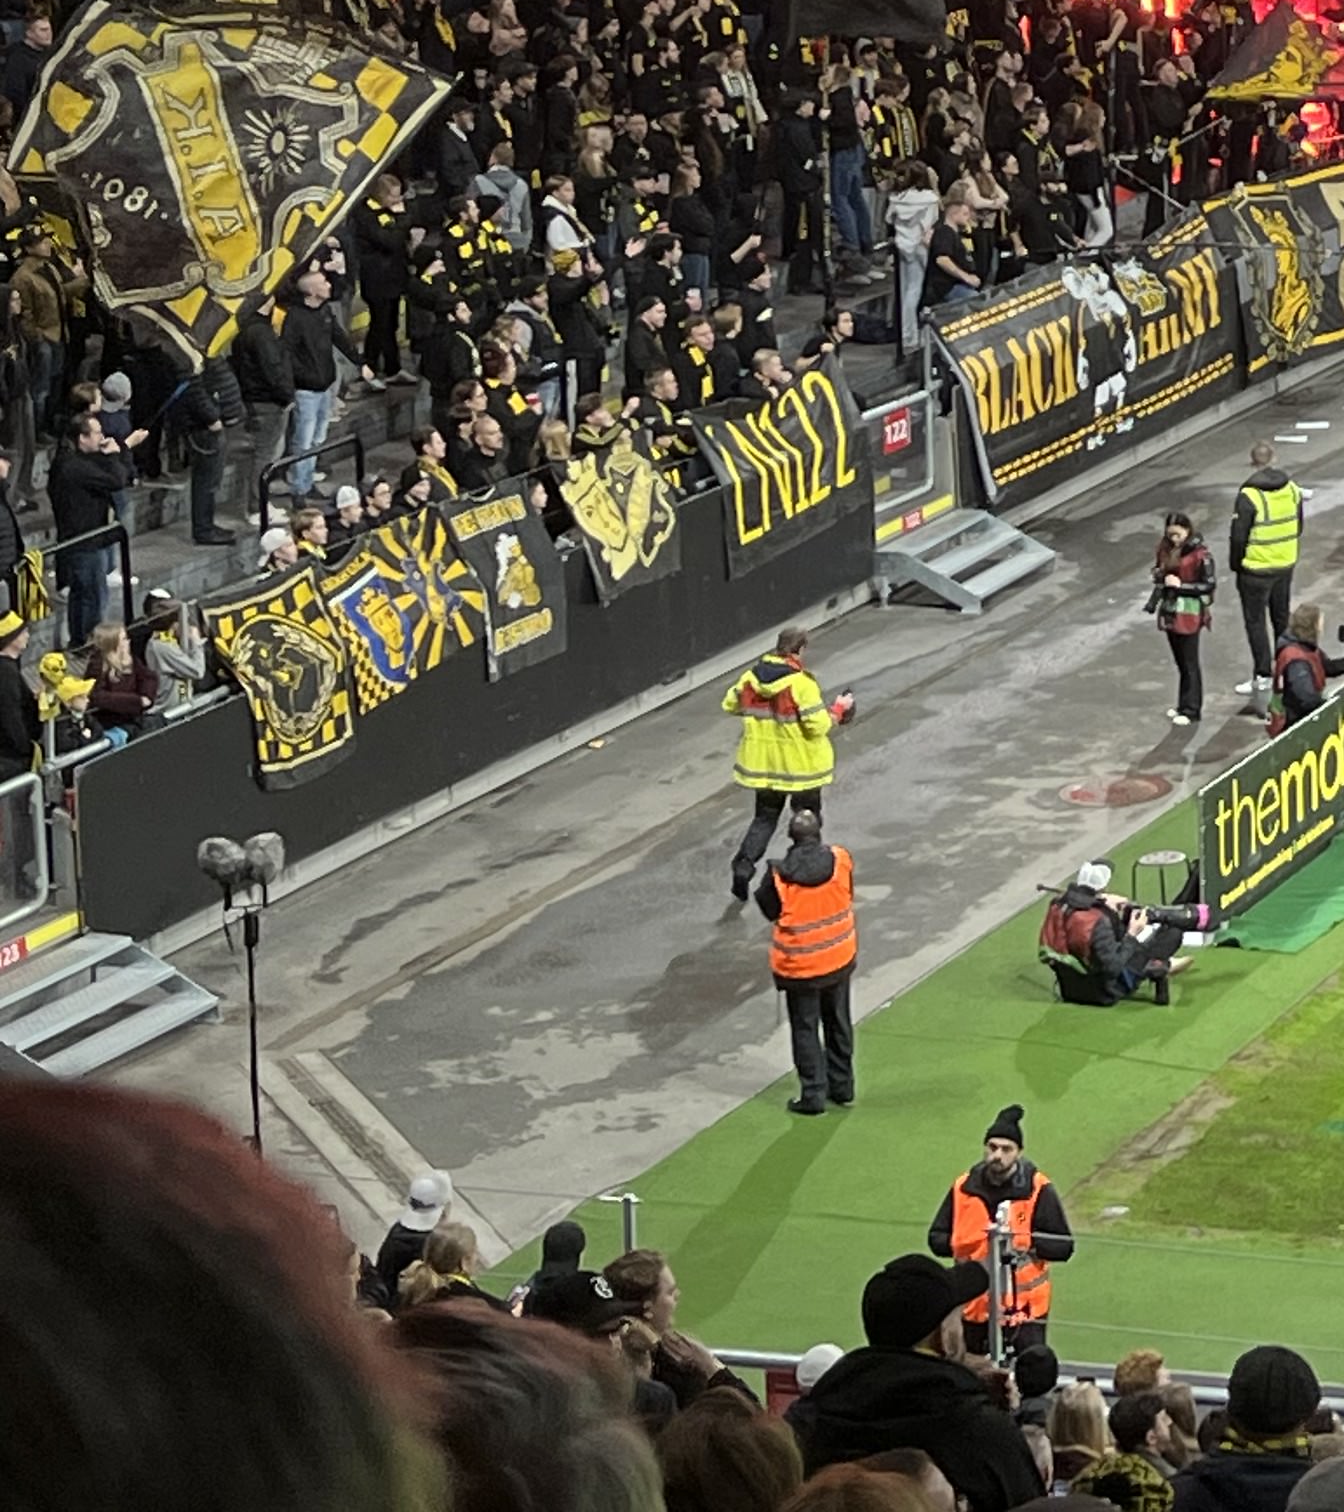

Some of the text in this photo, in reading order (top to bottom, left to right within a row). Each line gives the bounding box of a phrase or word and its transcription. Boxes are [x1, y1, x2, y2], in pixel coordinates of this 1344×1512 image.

[959, 315, 1078, 436] BLACK
[884, 417, 909, 446] 122
[0, 942, 20, 970] 23
